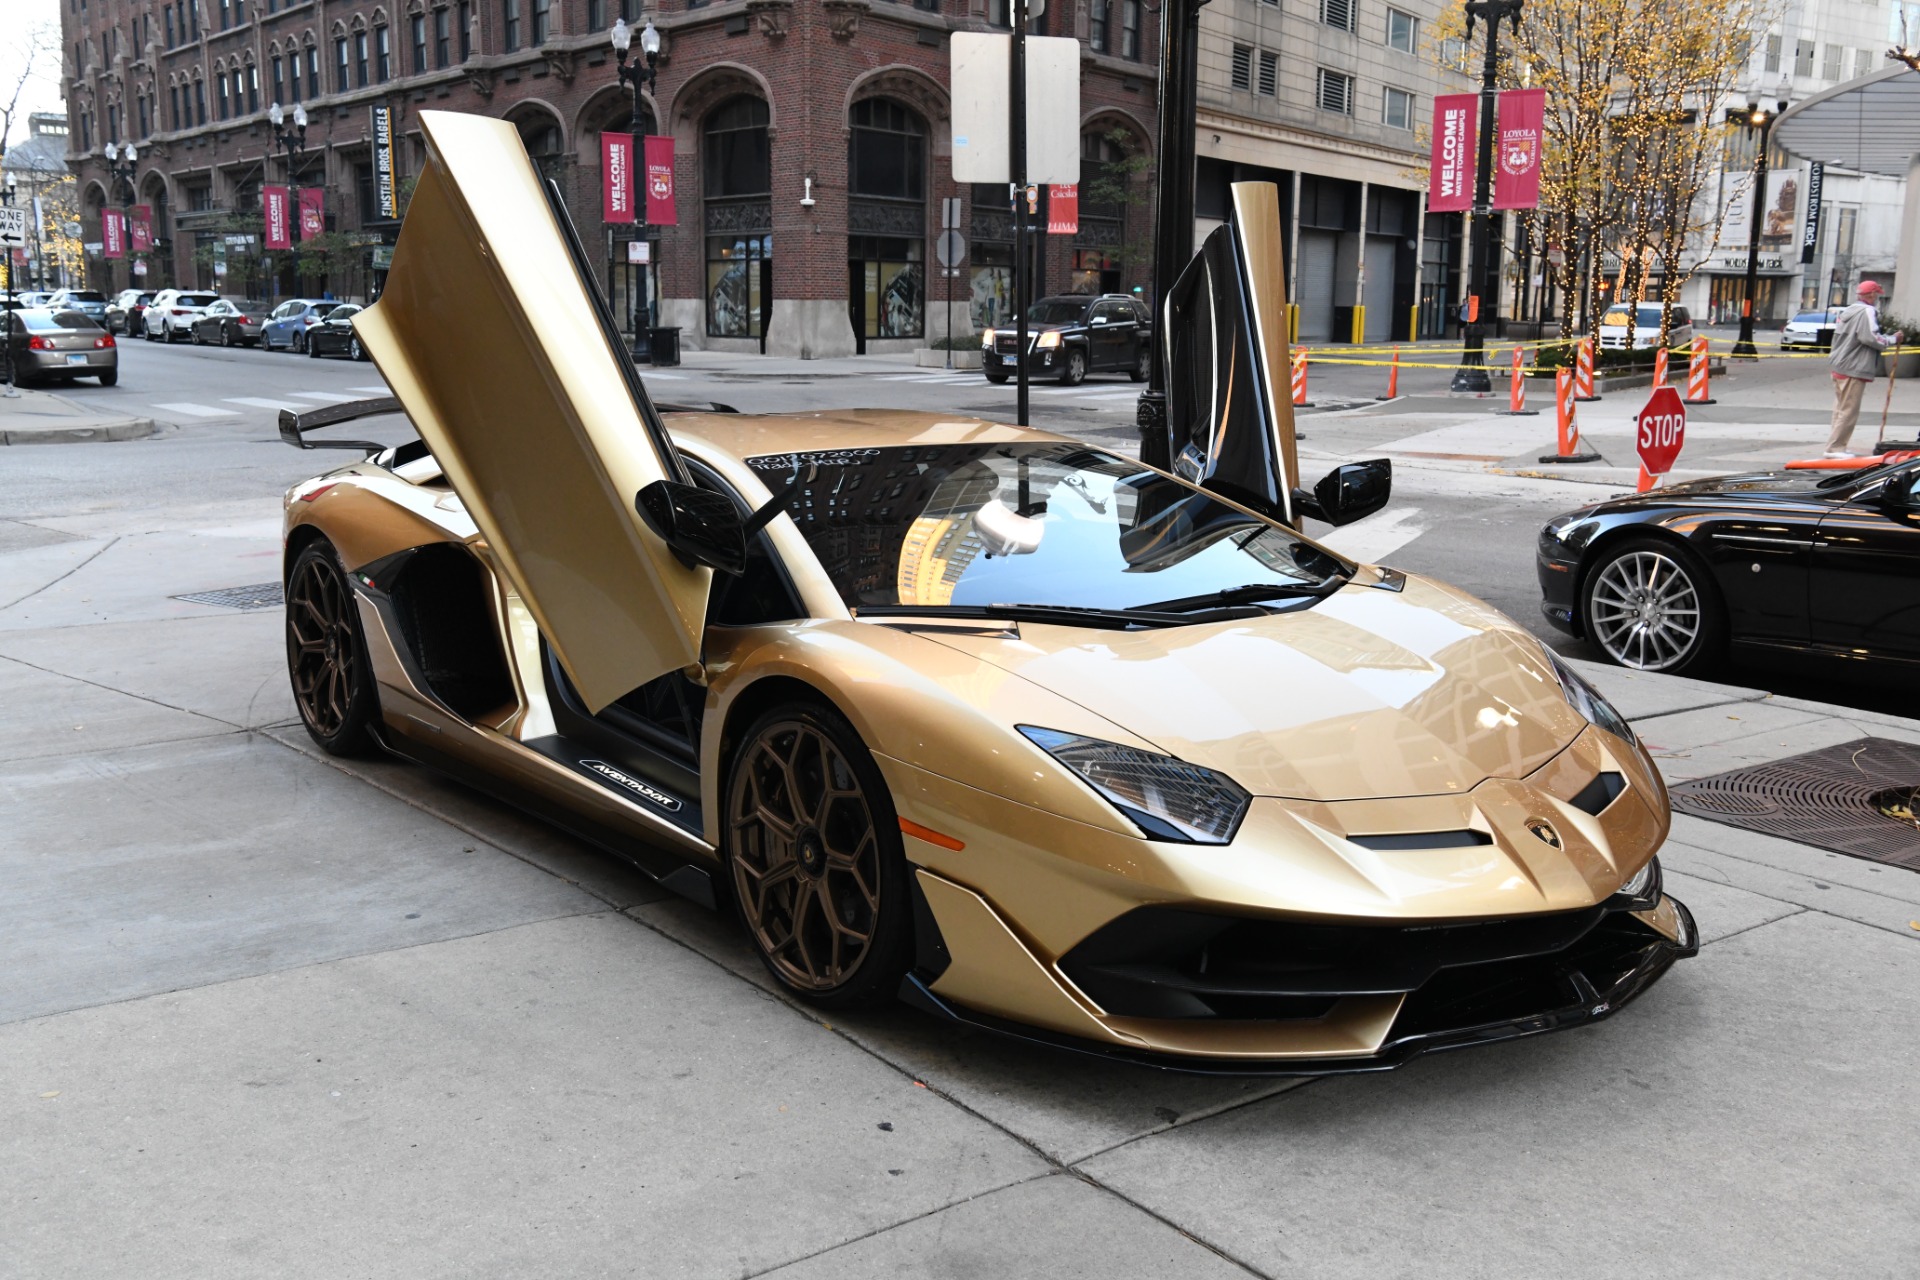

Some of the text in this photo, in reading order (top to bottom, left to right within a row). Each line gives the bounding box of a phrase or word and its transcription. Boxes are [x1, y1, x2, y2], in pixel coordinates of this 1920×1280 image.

[1503, 129, 1536, 137] LOYOLA
[376, 108, 393, 217] EINSTEIN BROS. BAGELS
[1441, 109, 1458, 197] WELCOME
[610, 144, 621, 211] WELCOME
[1455, 172, 1463, 197] WATER
[0, 210, 22, 221] ONE
[0, 221, 22, 231] WAY
[107, 215, 116, 251] WELCOME
[270, 194, 280, 241] WELCOME
[1049, 222, 1077, 232] LUMA
[1805, 222, 1816, 246] rack
[1640, 414, 1683, 449] STOP
[593, 765, 673, 805] AVENTADOR
